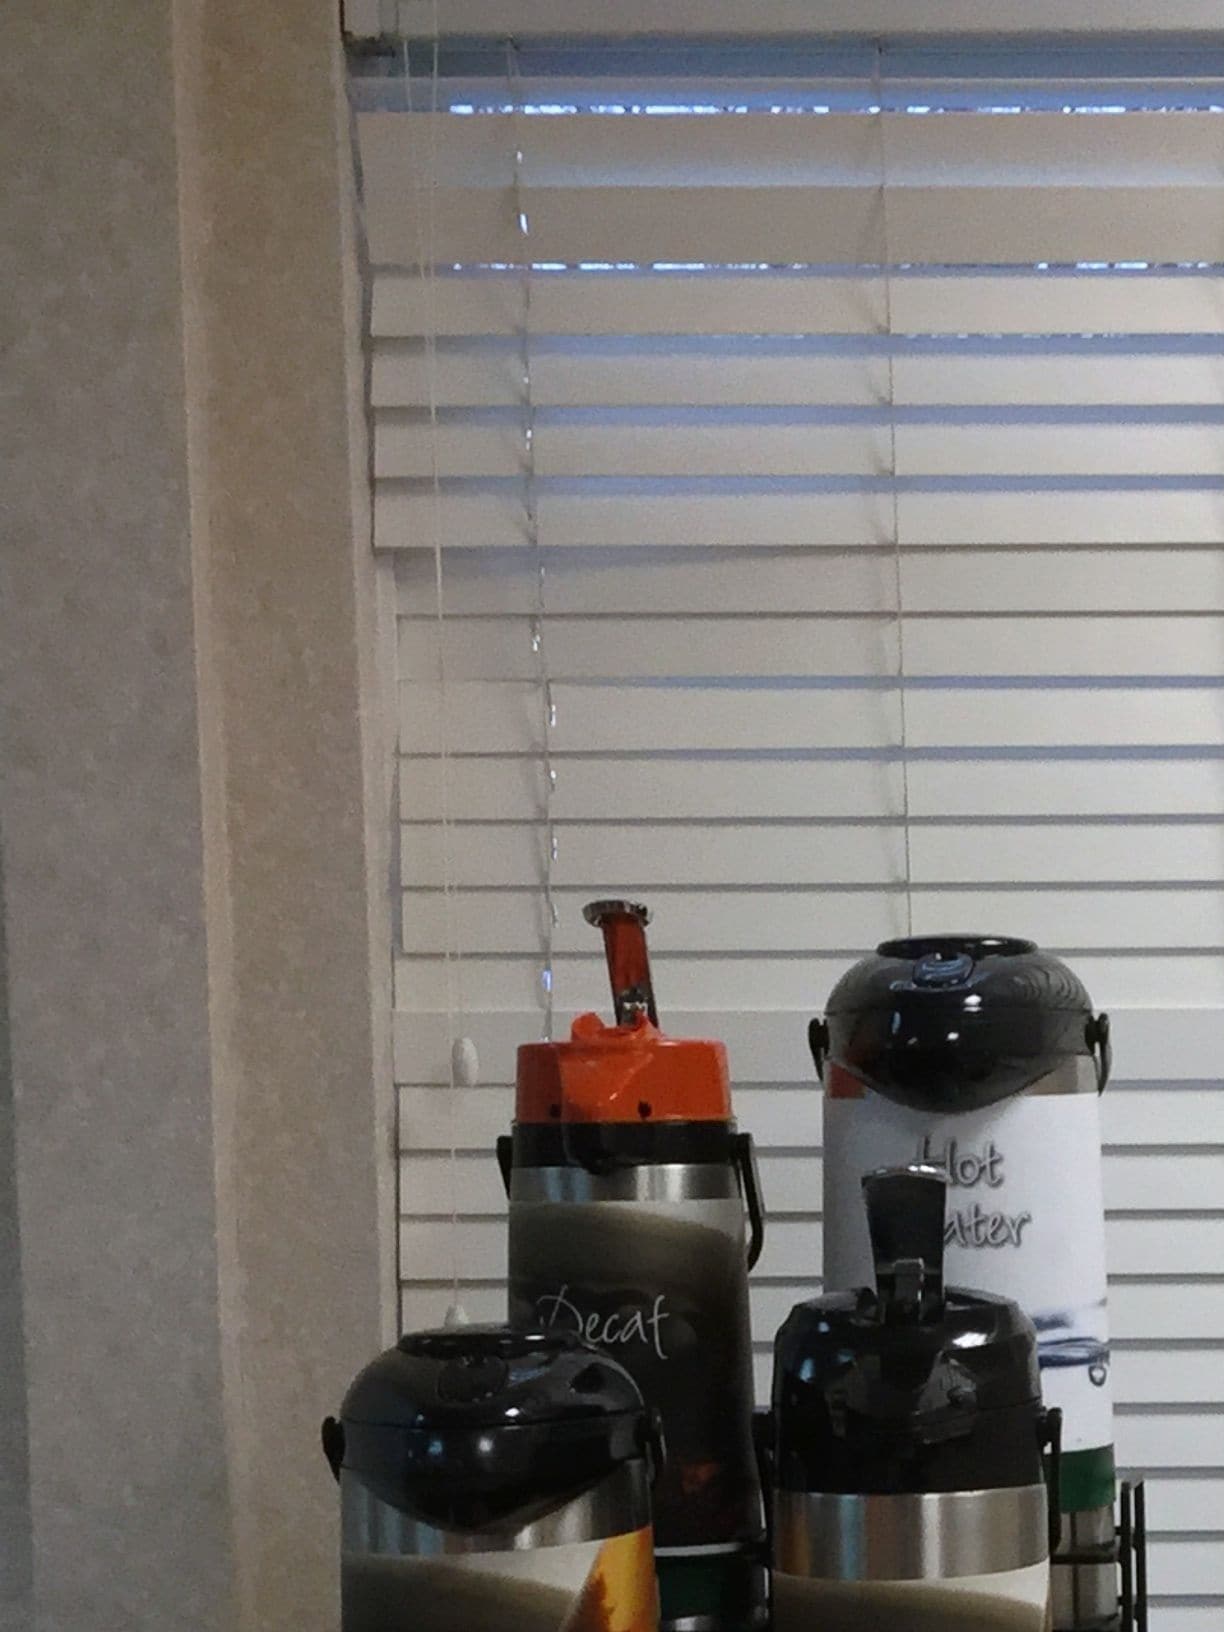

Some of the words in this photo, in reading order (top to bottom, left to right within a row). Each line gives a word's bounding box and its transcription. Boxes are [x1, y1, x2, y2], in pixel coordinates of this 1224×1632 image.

[912, 1135, 1004, 1188] Hot
[944, 1203, 1033, 1248] ater
[536, 1284, 671, 1360] Decaf
